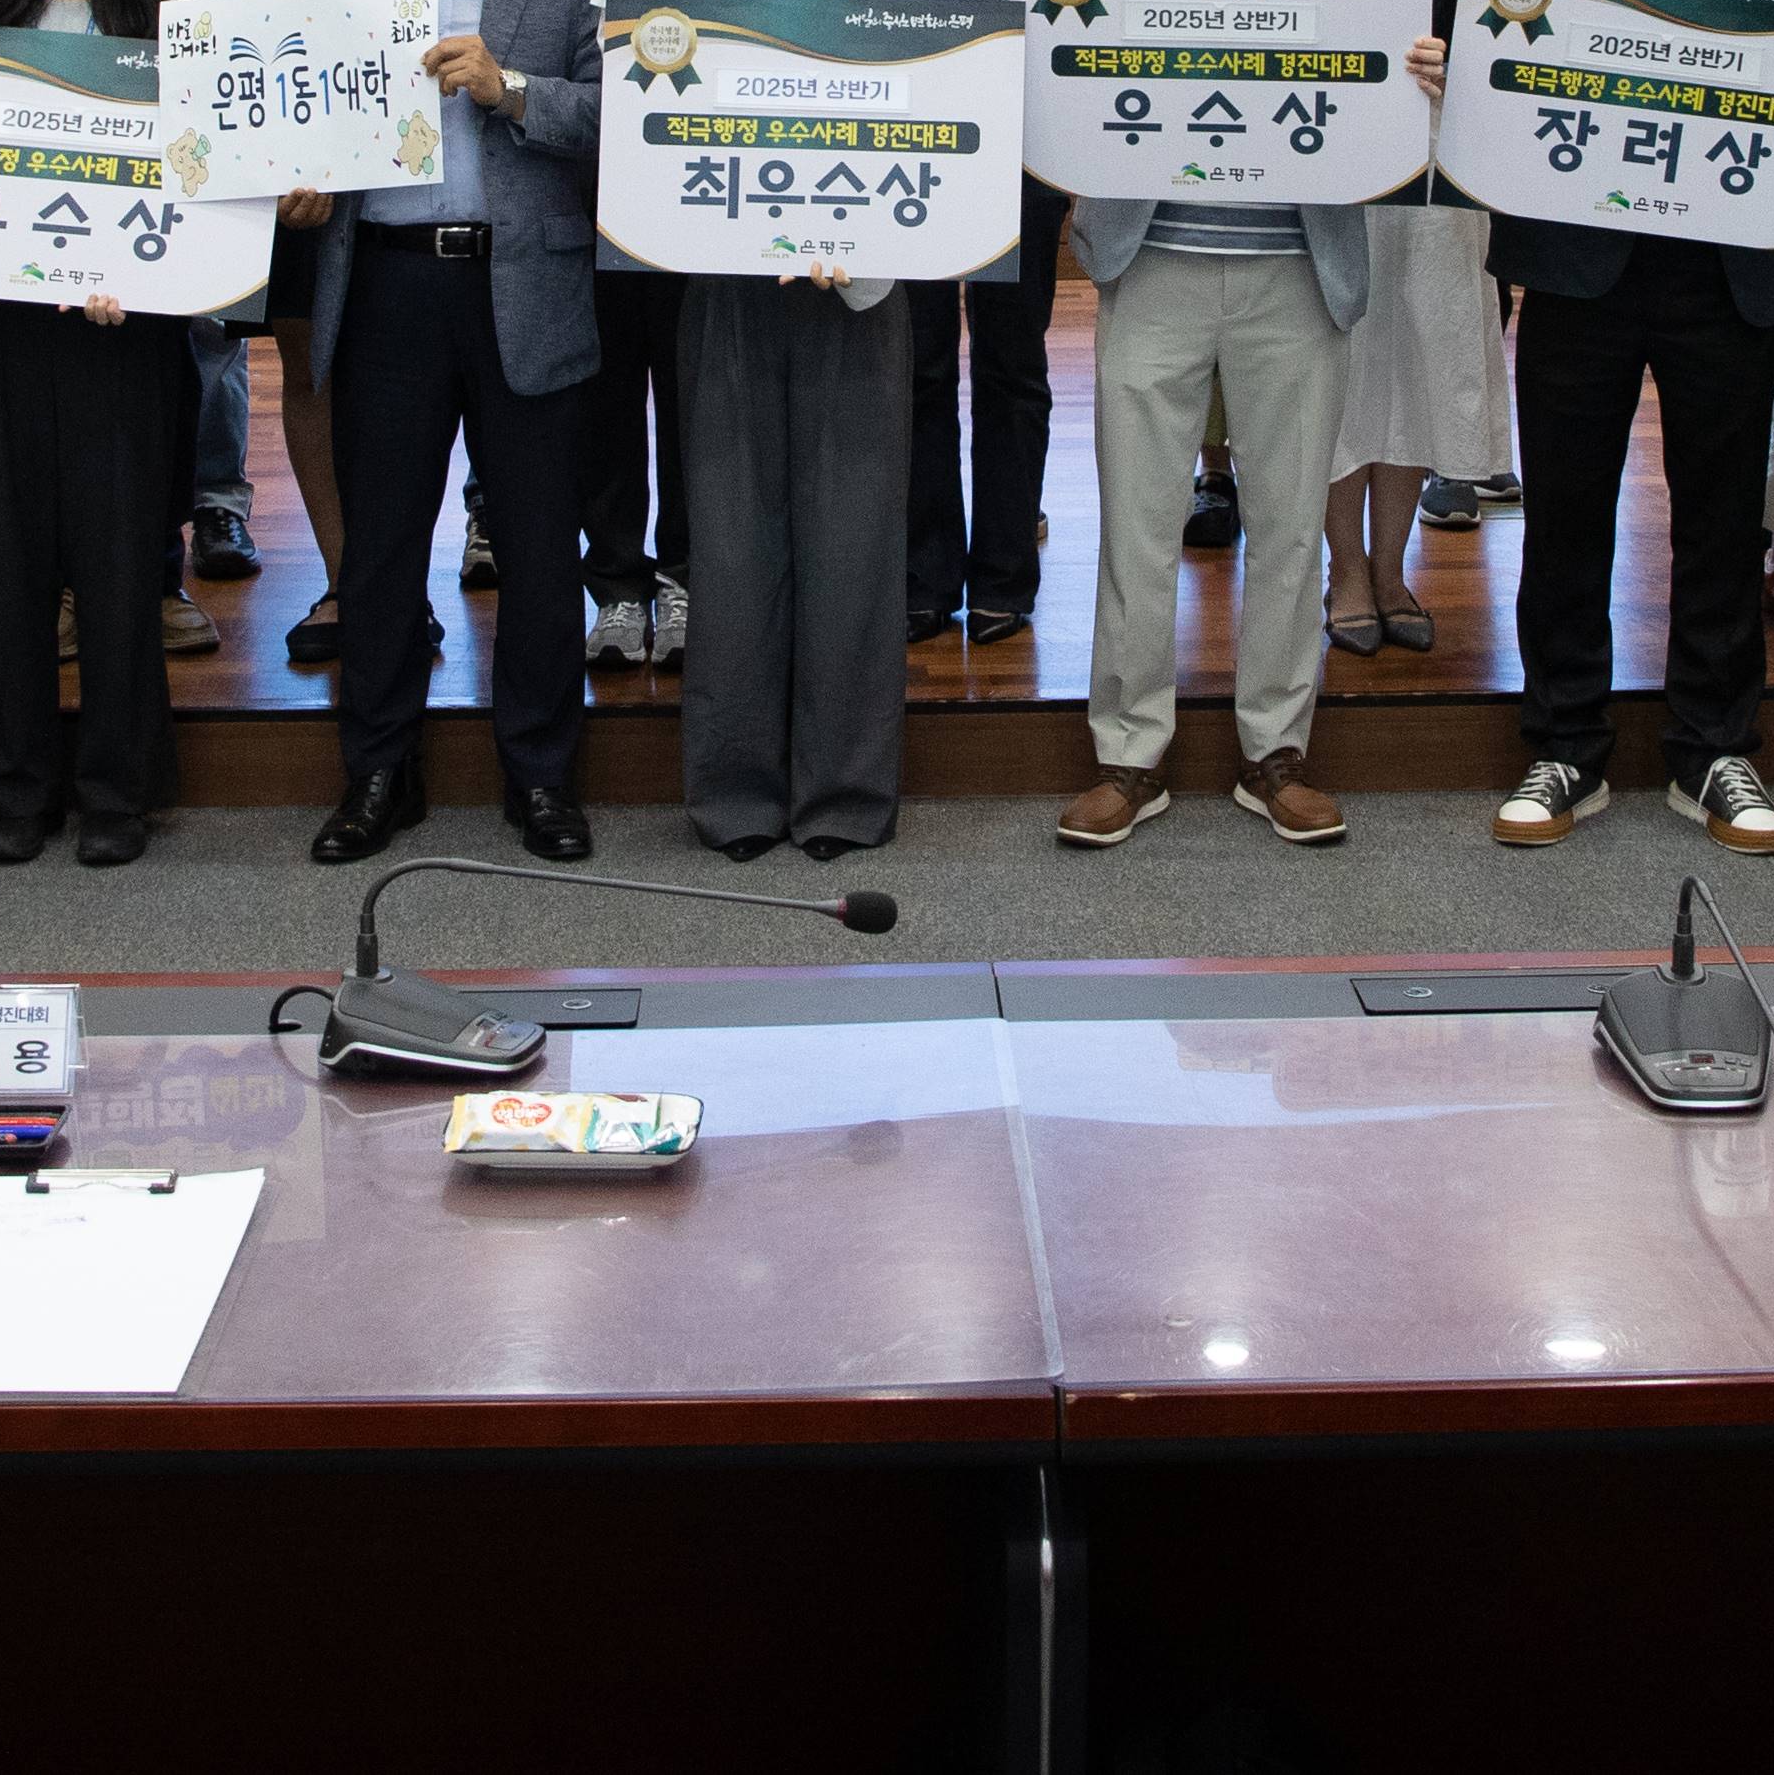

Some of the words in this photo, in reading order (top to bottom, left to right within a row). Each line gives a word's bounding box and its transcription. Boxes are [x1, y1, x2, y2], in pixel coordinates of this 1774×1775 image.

[166, 19, 191, 41] 바로
[391, 20, 431, 45] 최고야
[1143, 7, 1225, 31] 2025년
[1232, 10, 1298, 32] 상반기
[169, 38, 218, 60] 그거야!
[1074, 48, 1167, 76] 적극행정
[1173, 50, 1266, 77] 우수사례
[1274, 52, 1367, 79] 경진대회
[1588, 34, 1672, 64] 2025년
[1678, 44, 1745, 73] 상반기
[211, 66, 266, 131] 은평
[736, 75, 819, 99] 2025년
[825, 78, 890, 101] 상반기
[1513, 64, 1606, 99] 적극행정
[1611, 79, 1705, 112] 우수사례
[2, 108, 83, 133] 2025년
[90, 115, 153, 141] 상반기
[666, 116, 758, 145] 적극행정
[765, 120, 858, 148] 우수사례
[867, 122, 958, 150] 경진대회
[26, 149, 119, 183] 우수사례
[679, 155, 942, 228] 최우수상
